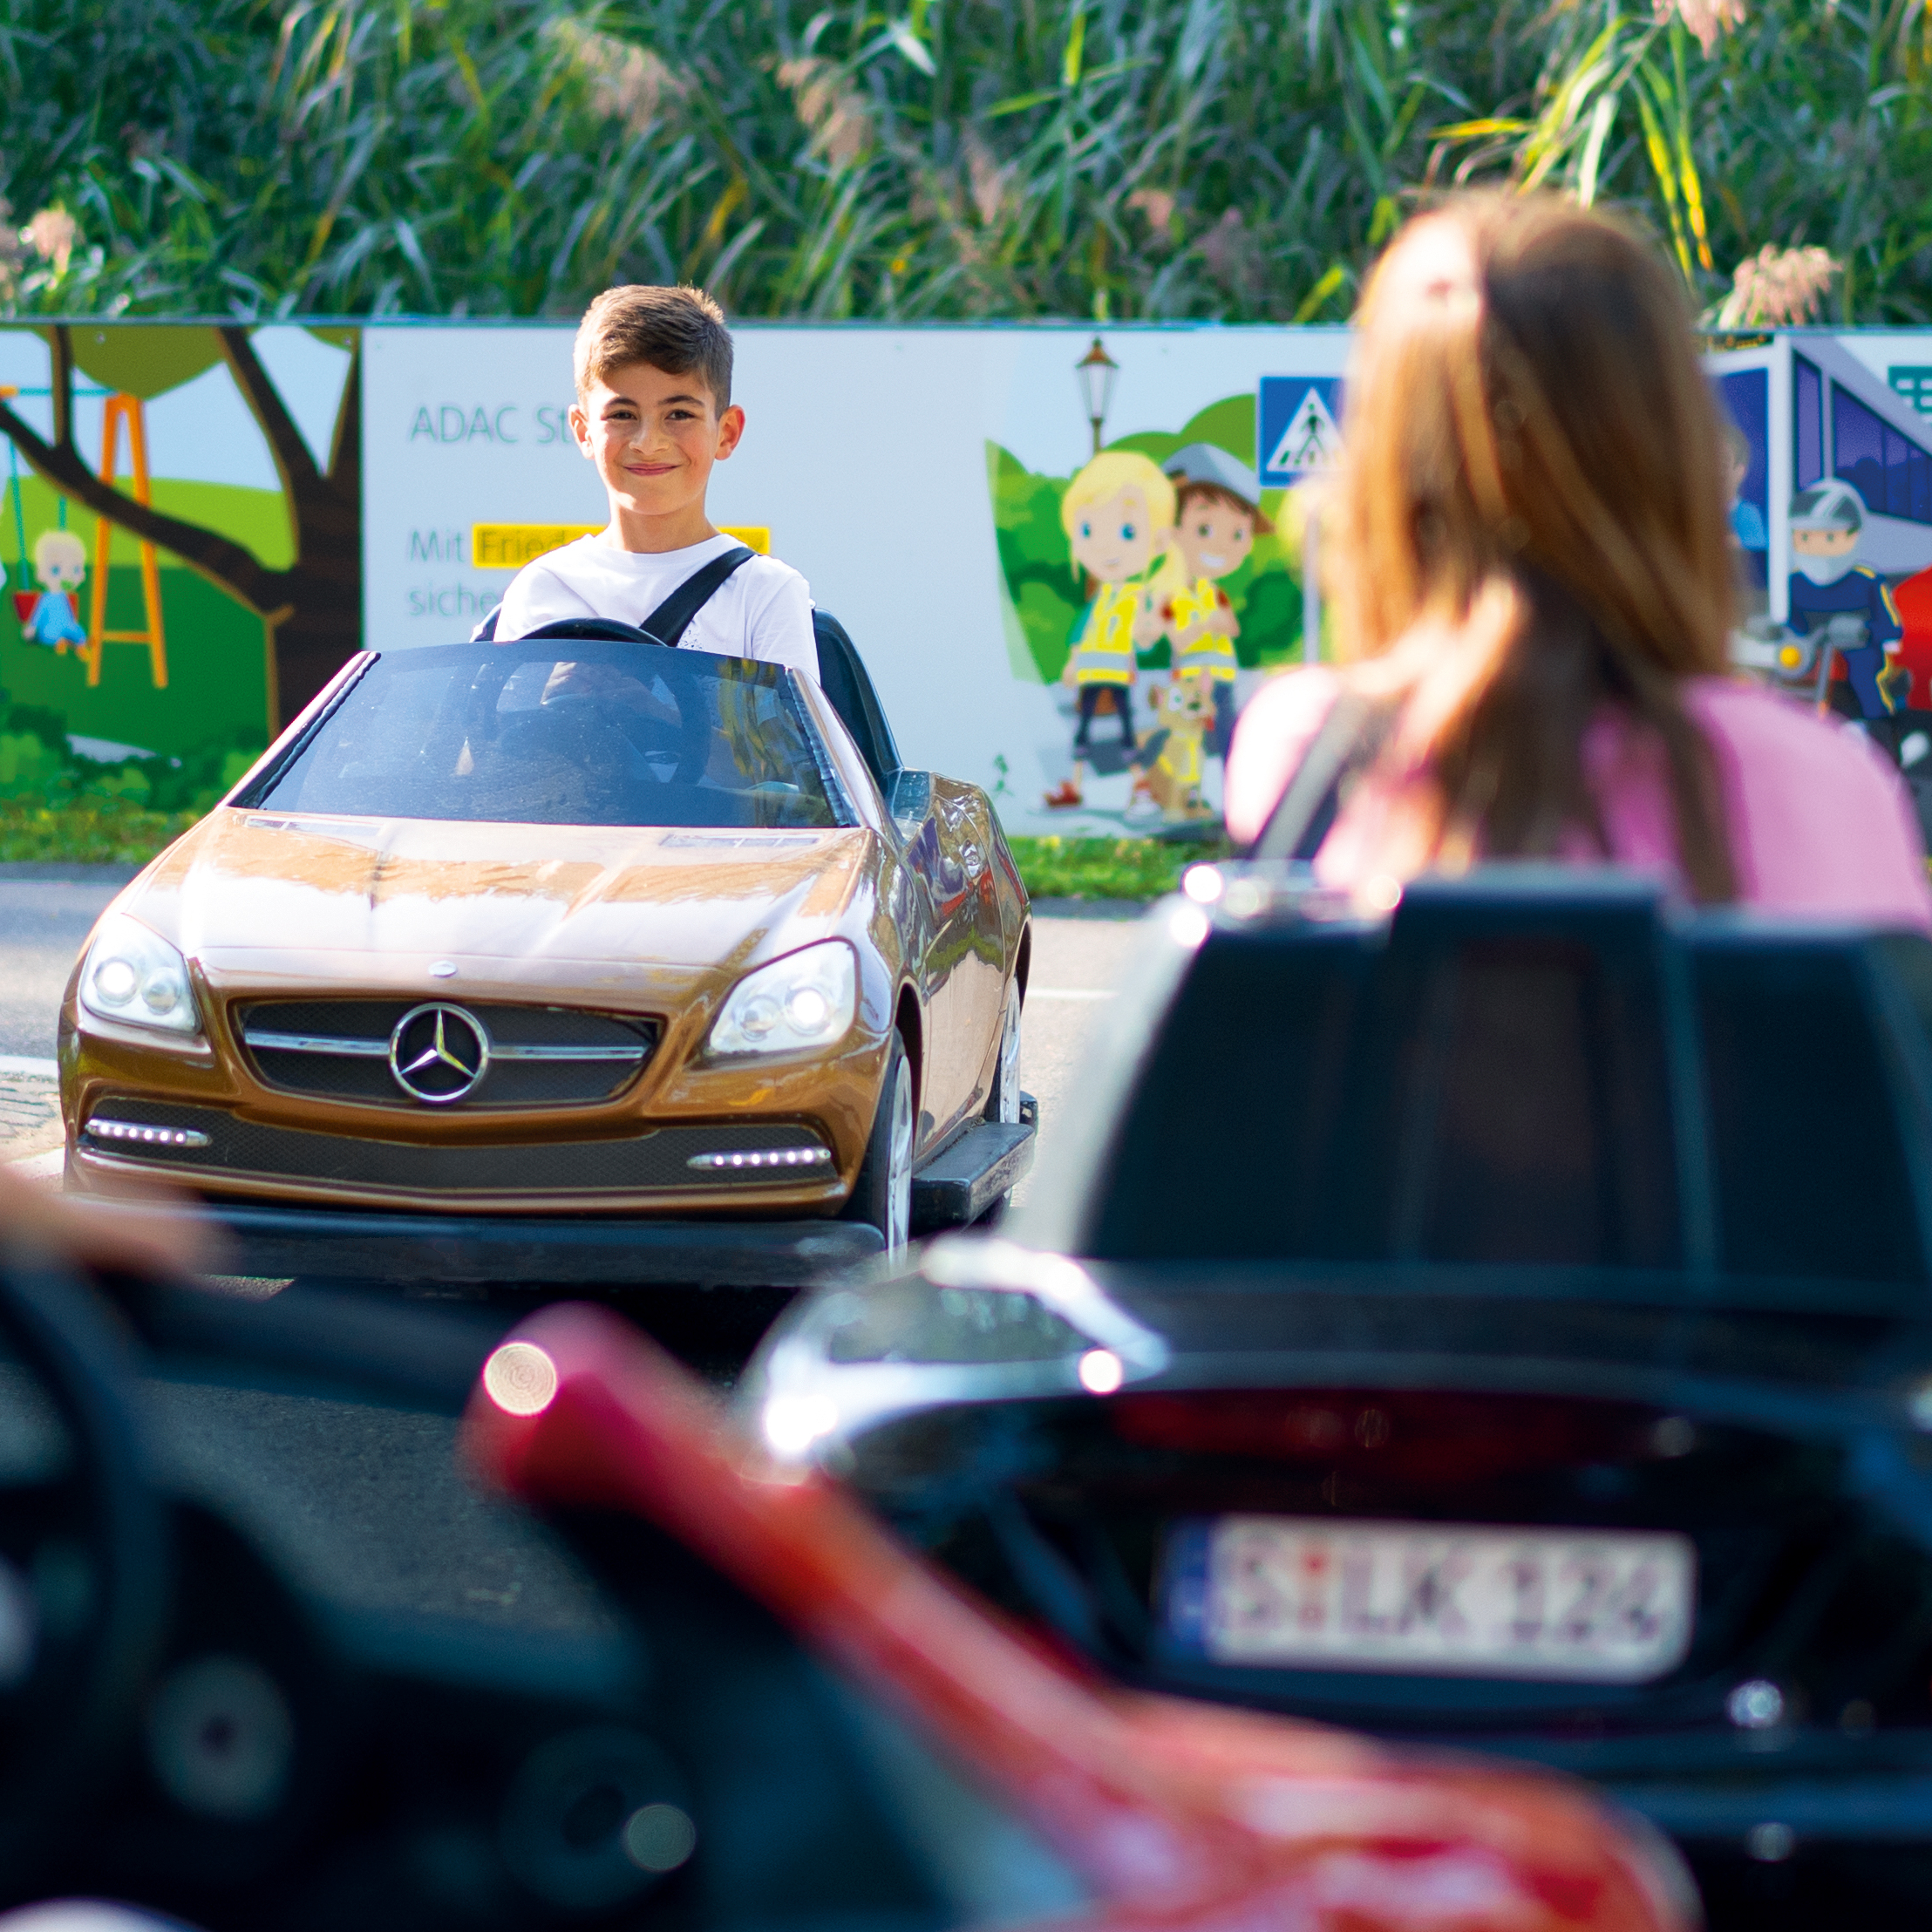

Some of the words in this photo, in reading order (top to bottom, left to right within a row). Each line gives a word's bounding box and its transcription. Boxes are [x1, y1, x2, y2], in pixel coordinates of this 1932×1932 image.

[409, 405, 519, 444] ADAC
[535, 405, 572, 445] St
[408, 528, 465, 563] Mit
[480, 528, 567, 563] Fried
[408, 581, 500, 617] siche
